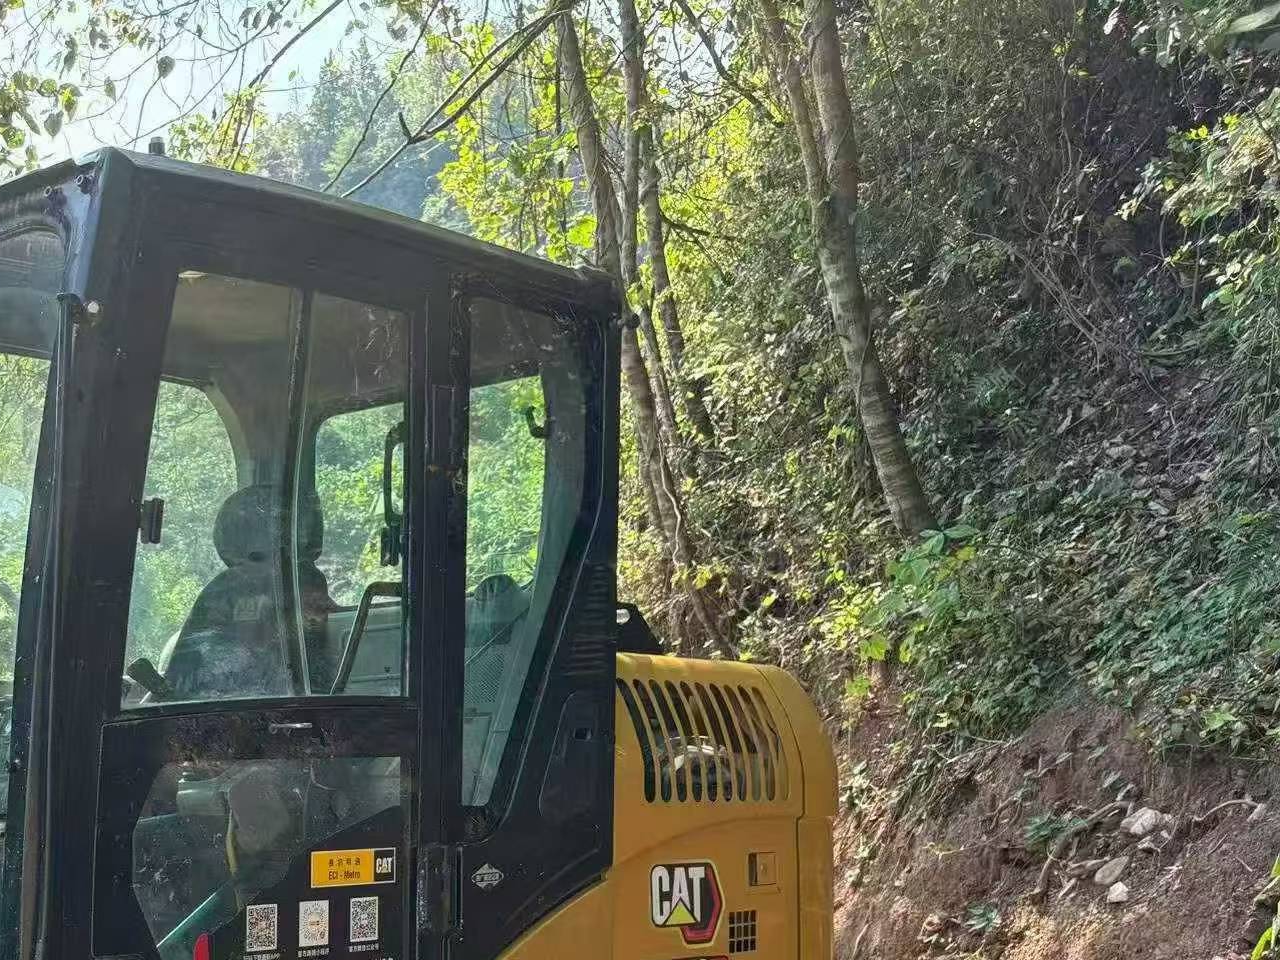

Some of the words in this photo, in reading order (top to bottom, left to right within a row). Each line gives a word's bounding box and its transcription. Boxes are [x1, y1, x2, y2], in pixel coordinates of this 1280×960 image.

[375, 857, 393, 874] CAT
[328, 871, 338, 880] ECI
[651, 865, 705, 925] CAT
